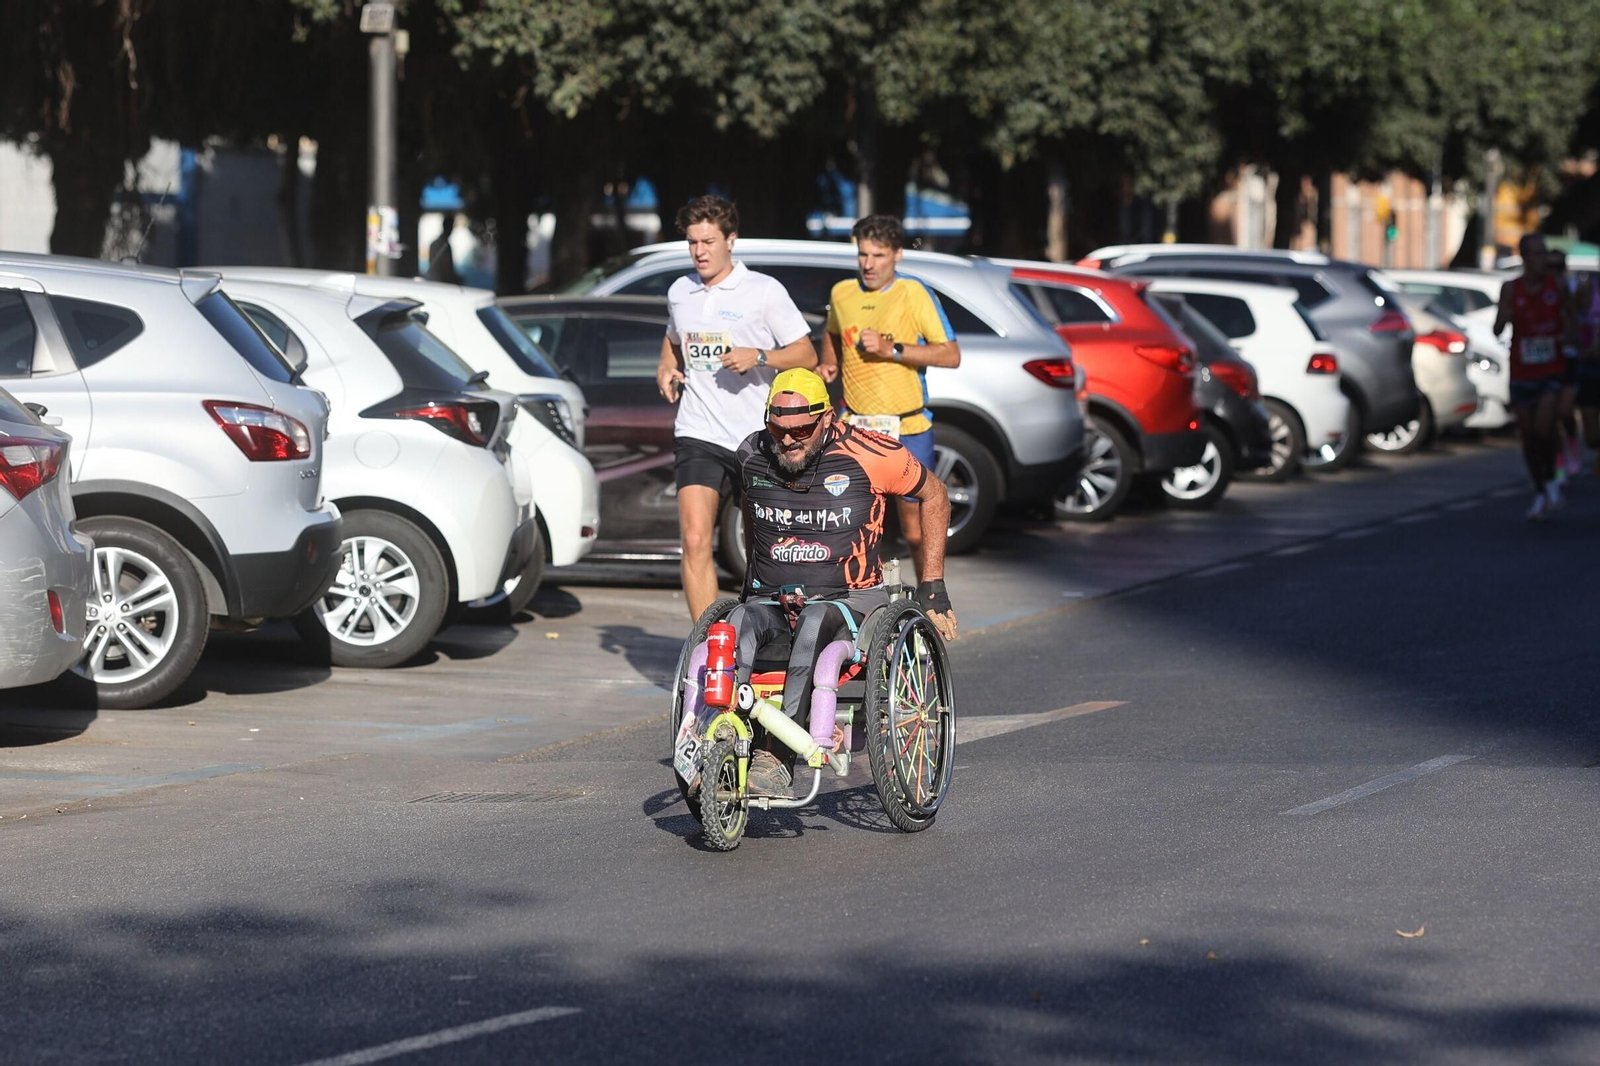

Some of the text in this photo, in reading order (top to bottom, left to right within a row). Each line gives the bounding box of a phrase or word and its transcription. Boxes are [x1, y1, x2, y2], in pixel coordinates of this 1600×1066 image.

[689, 345, 723, 358] 344
[795, 510, 812, 524] del
[816, 507, 851, 531] MAR
[773, 544, 827, 562] Sigfrido
